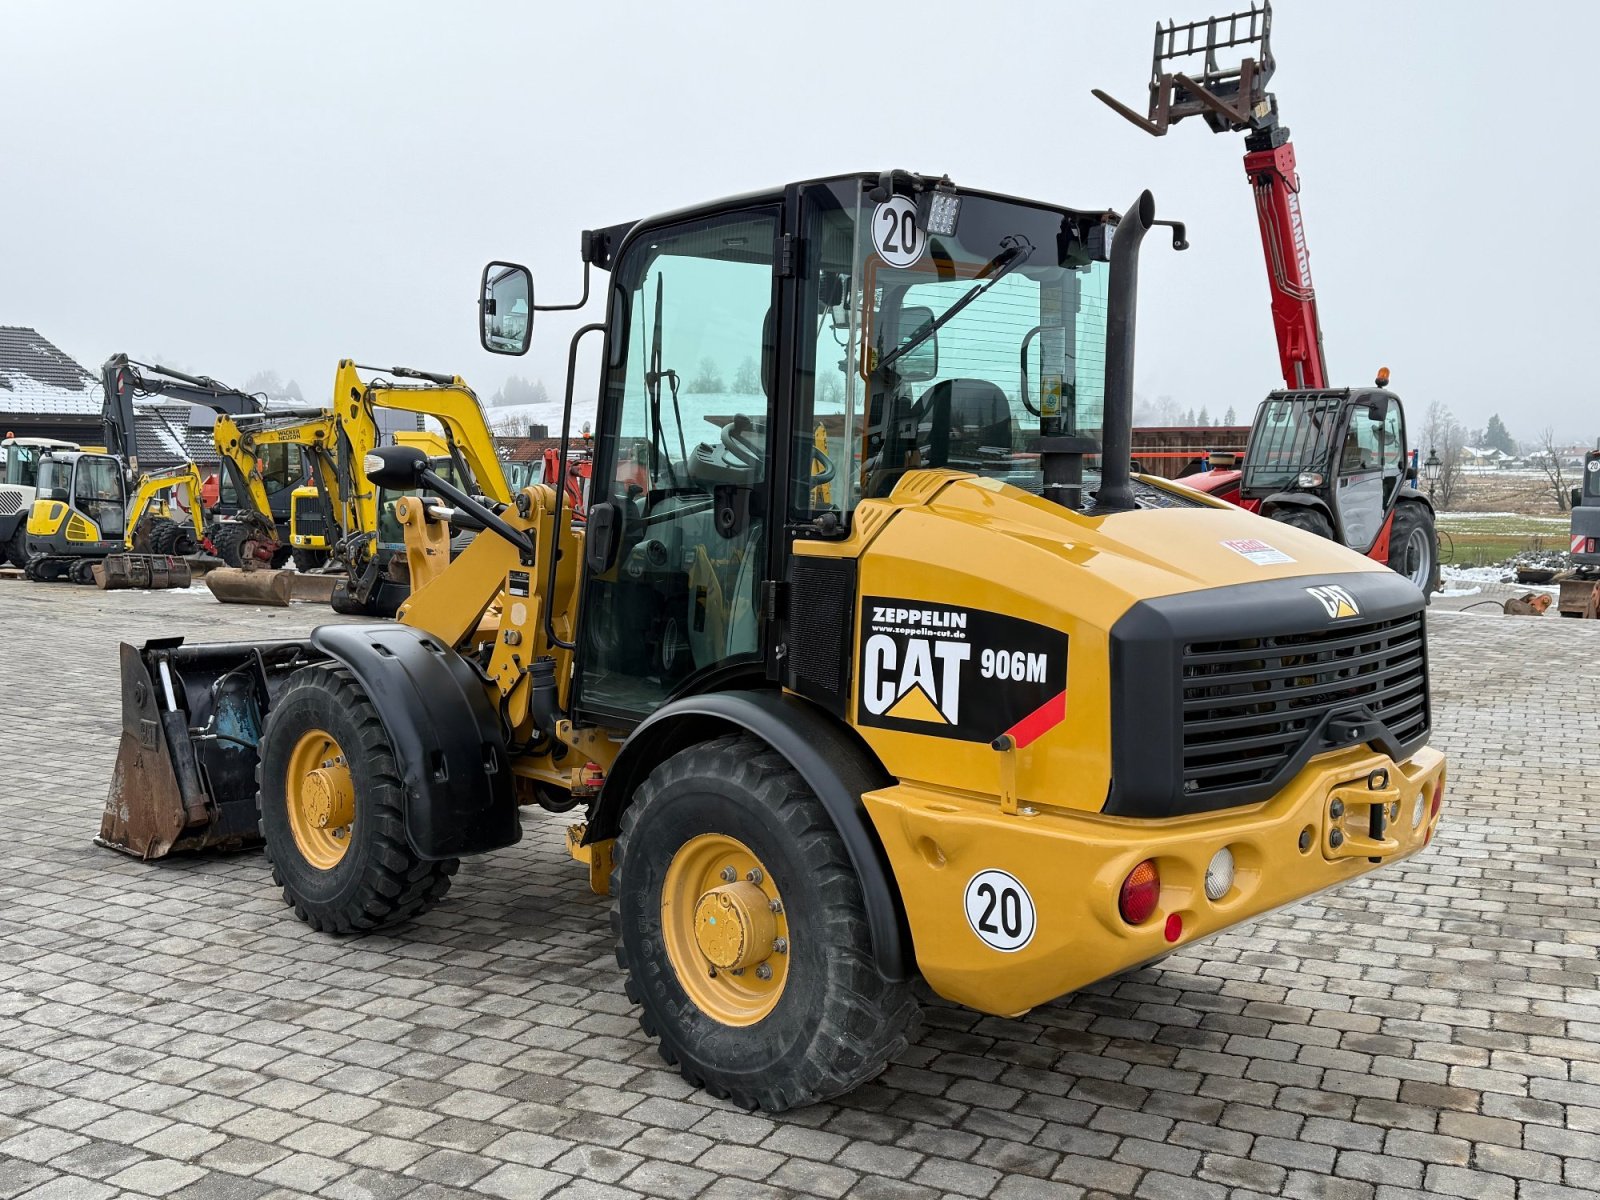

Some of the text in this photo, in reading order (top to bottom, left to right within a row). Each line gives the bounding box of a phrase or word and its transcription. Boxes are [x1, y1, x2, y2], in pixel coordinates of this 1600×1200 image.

[882, 207, 916, 254] 20
[1287, 192, 1311, 288] MANITOU
[278, 433, 301, 441] NEUSON
[872, 606, 968, 629] ZEPPELIN
[1305, 584, 1360, 619] CAT
[863, 634, 1048, 726] CAT 906M
[977, 882, 1022, 939] 20
